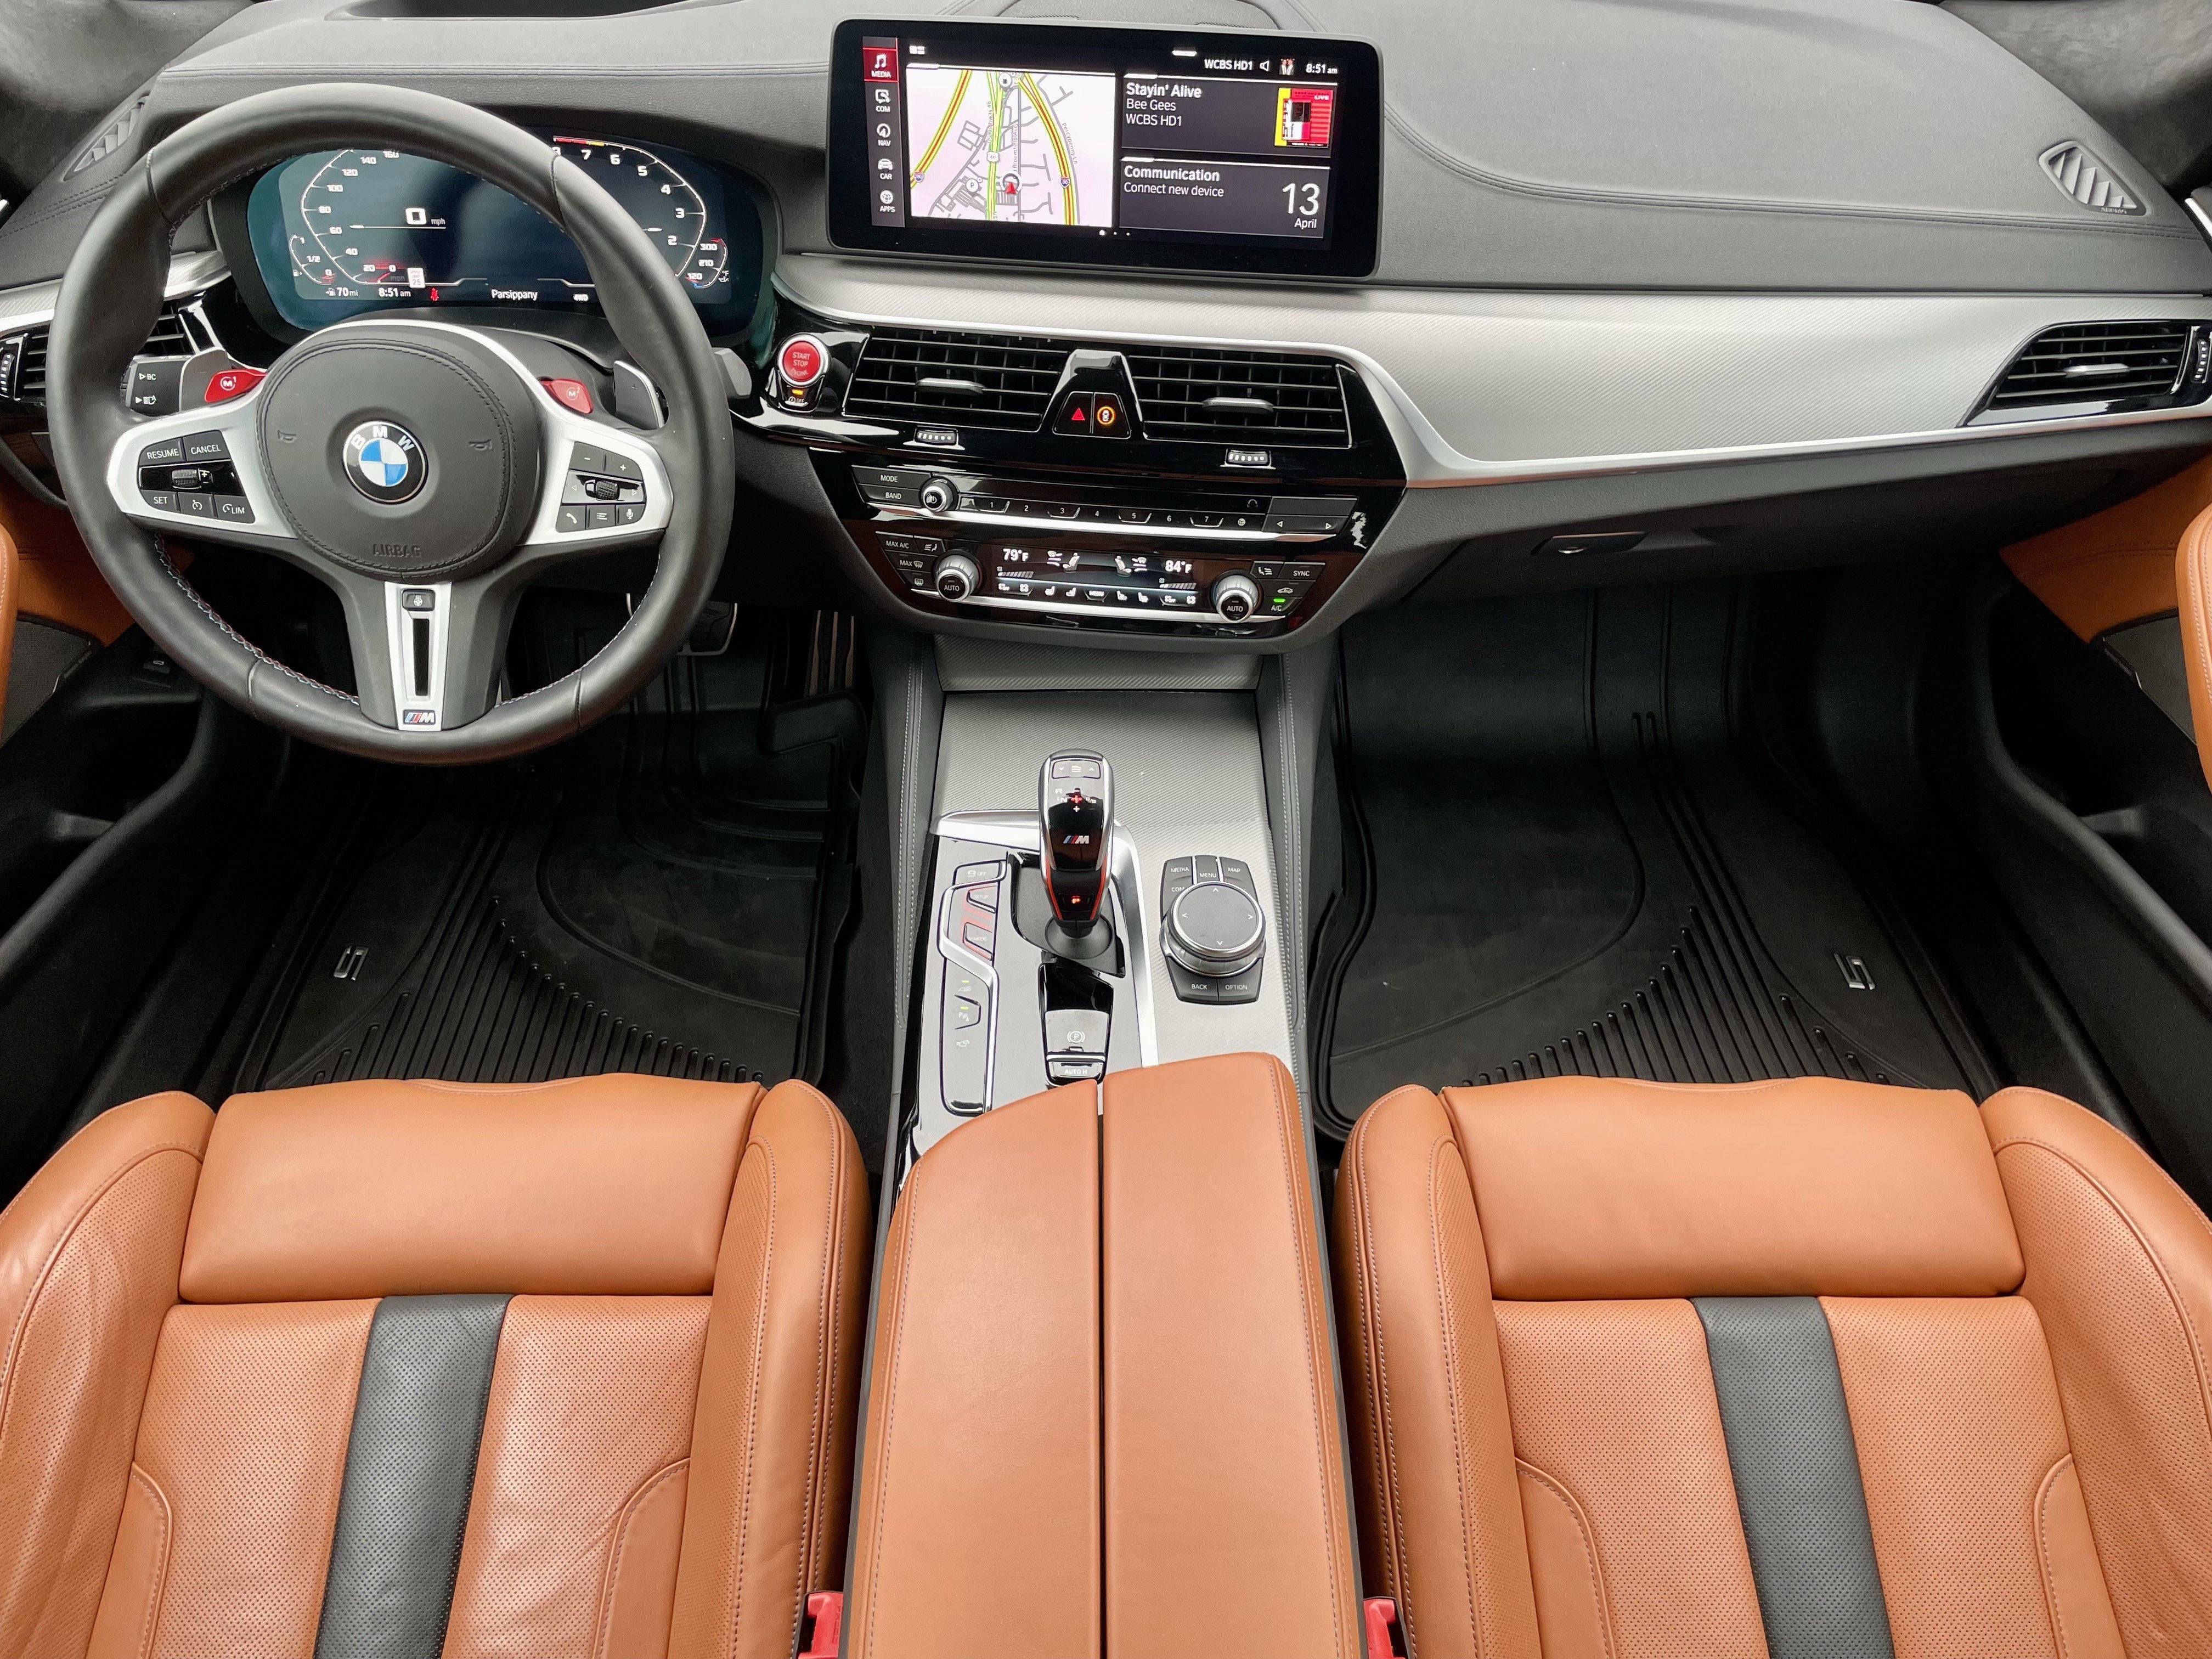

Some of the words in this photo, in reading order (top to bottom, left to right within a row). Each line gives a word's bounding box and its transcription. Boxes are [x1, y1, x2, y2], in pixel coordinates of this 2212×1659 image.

[1204, 59, 1231, 70] WCBS
[1233, 60, 1253, 70] HD1
[1306, 64, 1326, 74] 8:51
[1126, 83, 1169, 97] Stayin'
[1171, 84, 1201, 98] Alive
[1126, 99, 1147, 110] Bee
[1149, 99, 1176, 111] Gees
[1126, 114, 1158, 126] WCBS
[1160, 115, 1182, 127] HD1
[581, 149, 591, 160] 7
[610, 154, 620, 165] 6
[360, 156, 376, 165] 140
[342, 168, 358, 177] 120
[637, 166, 647, 176] 5
[1124, 165, 1220, 181] Communication
[327, 184, 343, 193] 100
[660, 185, 670, 195] 4
[1124, 182, 1166, 194] Connect
[1169, 185, 1189, 195] new
[1192, 184, 1224, 197] device
[1282, 183, 1320, 215] 13
[405, 207, 426, 225] 0
[675, 208, 685, 218] 3
[1294, 218, 1317, 229] April
[667, 235, 678, 245] 2
[345, 247, 358, 256] 40
[336, 287, 349, 297] 70
[379, 287, 398, 297] 8:51
[491, 290, 538, 301] Parsippany
[573, 294, 588, 302] 4WD
[792, 352, 811, 360] START
[351, 425, 415, 451] BMW
[146, 448, 179, 460] RESUME
[190, 444, 221, 455] CANCEL
[880, 474, 898, 483] MODE
[154, 496, 167, 505] SET
[885, 492, 901, 500] BAND
[232, 506, 245, 515] LIM
